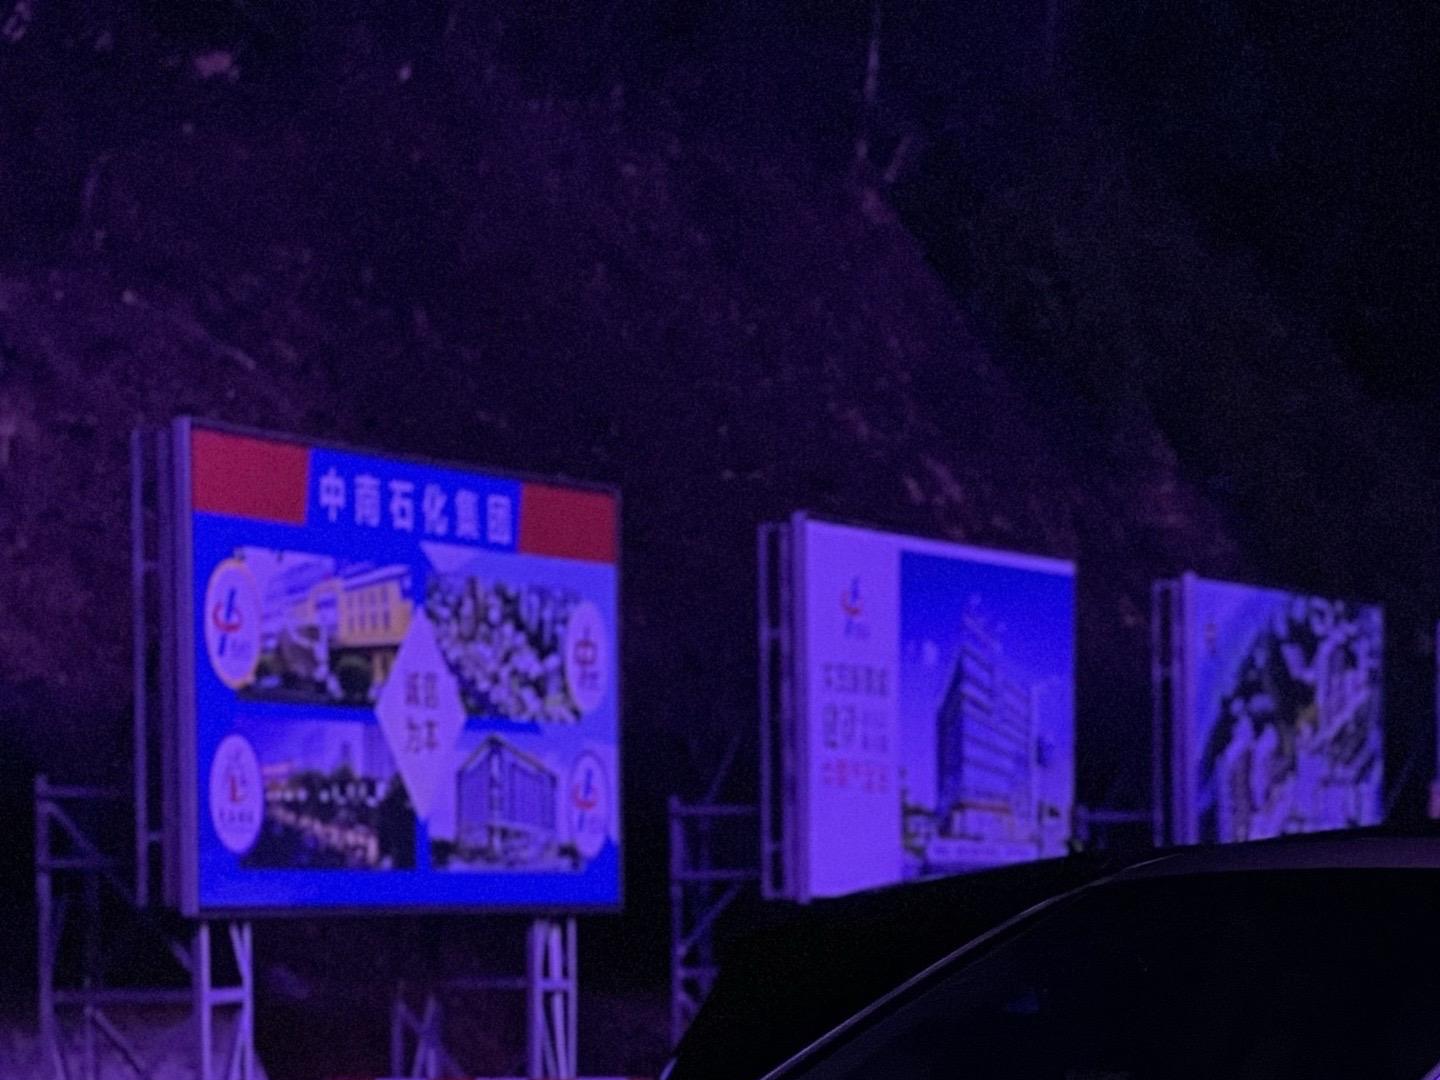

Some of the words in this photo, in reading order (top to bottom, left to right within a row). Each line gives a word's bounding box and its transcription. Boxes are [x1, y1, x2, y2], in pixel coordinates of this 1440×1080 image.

[317, 465, 513, 546] 中南石化集团
